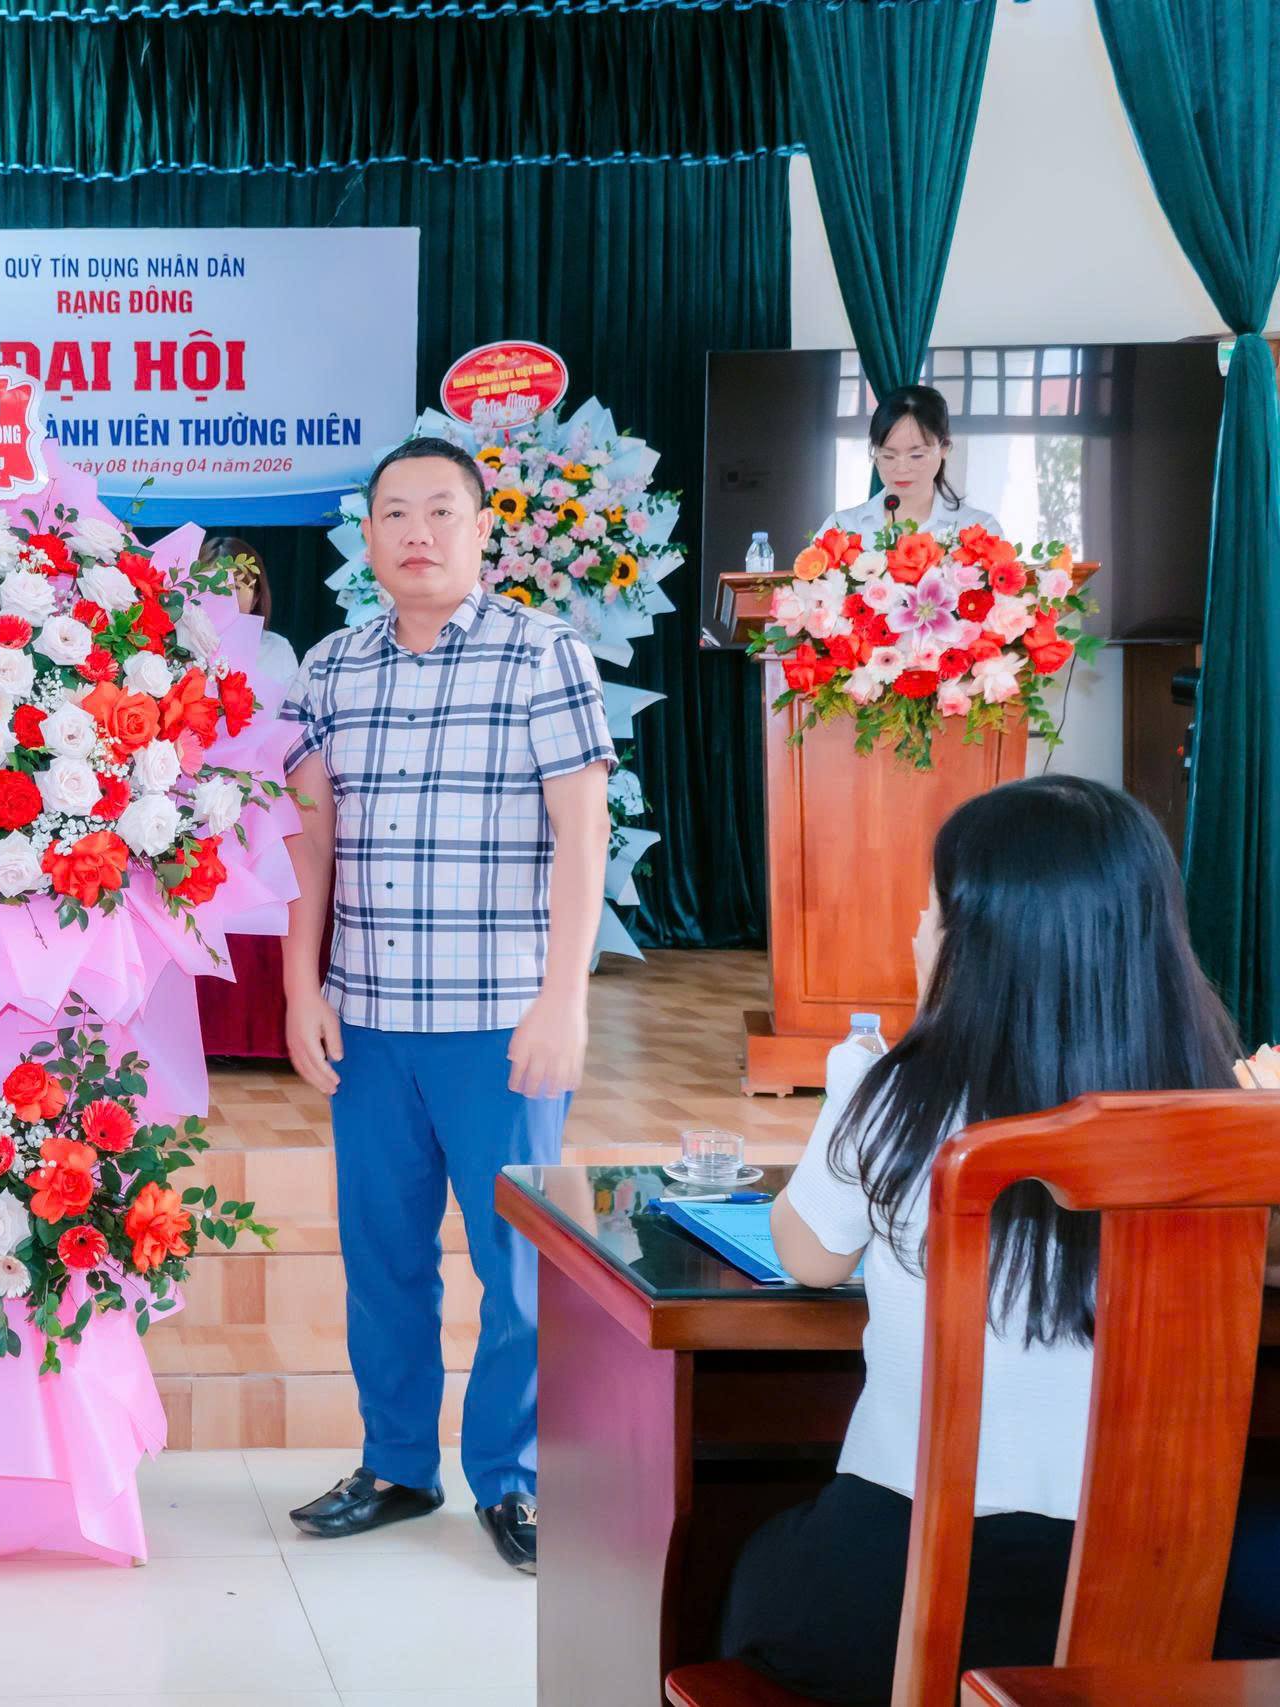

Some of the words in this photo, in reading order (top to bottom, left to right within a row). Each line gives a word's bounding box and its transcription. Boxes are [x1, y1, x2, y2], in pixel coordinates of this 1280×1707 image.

[5, 254, 42, 279] QUỸ
[50, 254, 79, 278] TÍN
[88, 257, 139, 282] DỤNG
[147, 254, 198, 278] NHÂN
[208, 254, 245, 278] DÂN
[57, 290, 120, 319] RẠNG
[129, 285, 193, 313] ĐÔNG
[134, 330, 246, 402] HỘI
[45, 413, 98, 446] ÀNH
[108, 413, 169, 446] VIÊN
[179, 411, 287, 446] THƯỜNG
[296, 412, 361, 446] NIÊN
[106, 458, 126, 473] 08
[132, 457, 184, 477] tháng
[186, 458, 207, 473] 04
[212, 457, 250, 473] năm
[252, 457, 293, 473] 2026
